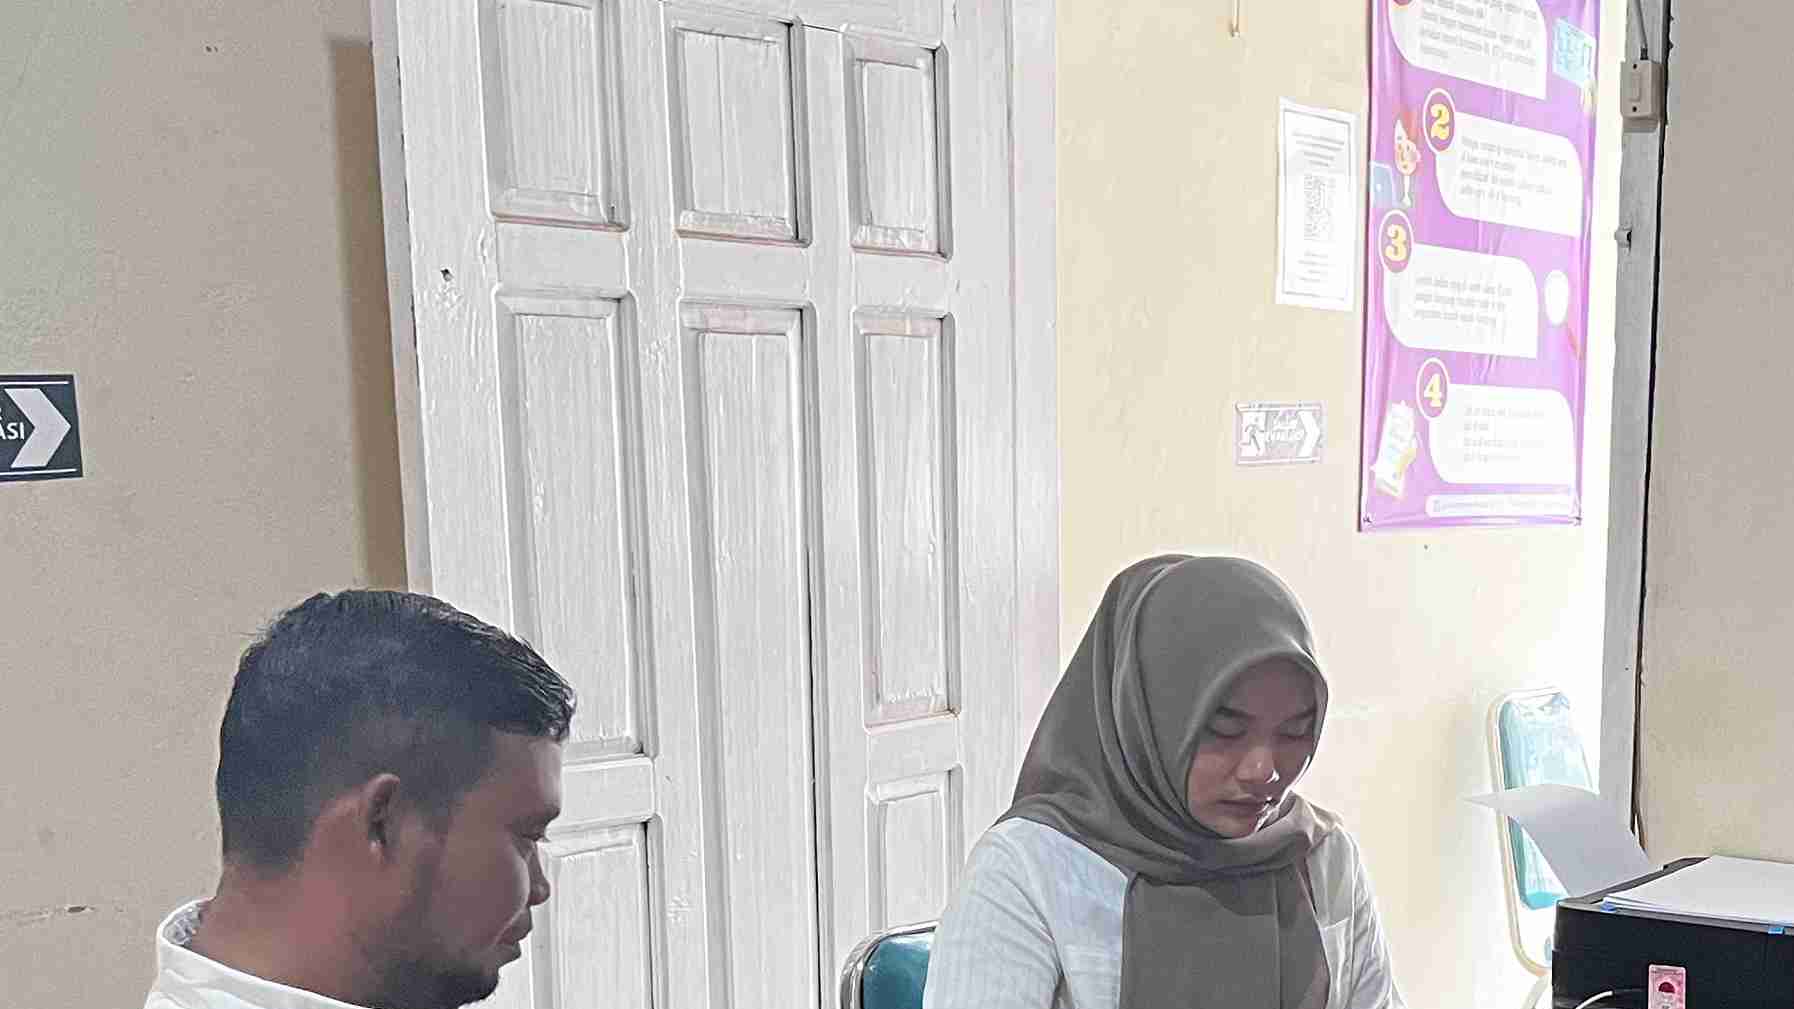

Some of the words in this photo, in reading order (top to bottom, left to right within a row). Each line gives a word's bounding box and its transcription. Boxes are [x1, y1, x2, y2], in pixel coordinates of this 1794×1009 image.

[1430, 103, 1450, 140] 2
[1385, 223, 1408, 262] 3
[1423, 373, 1442, 408] 4
